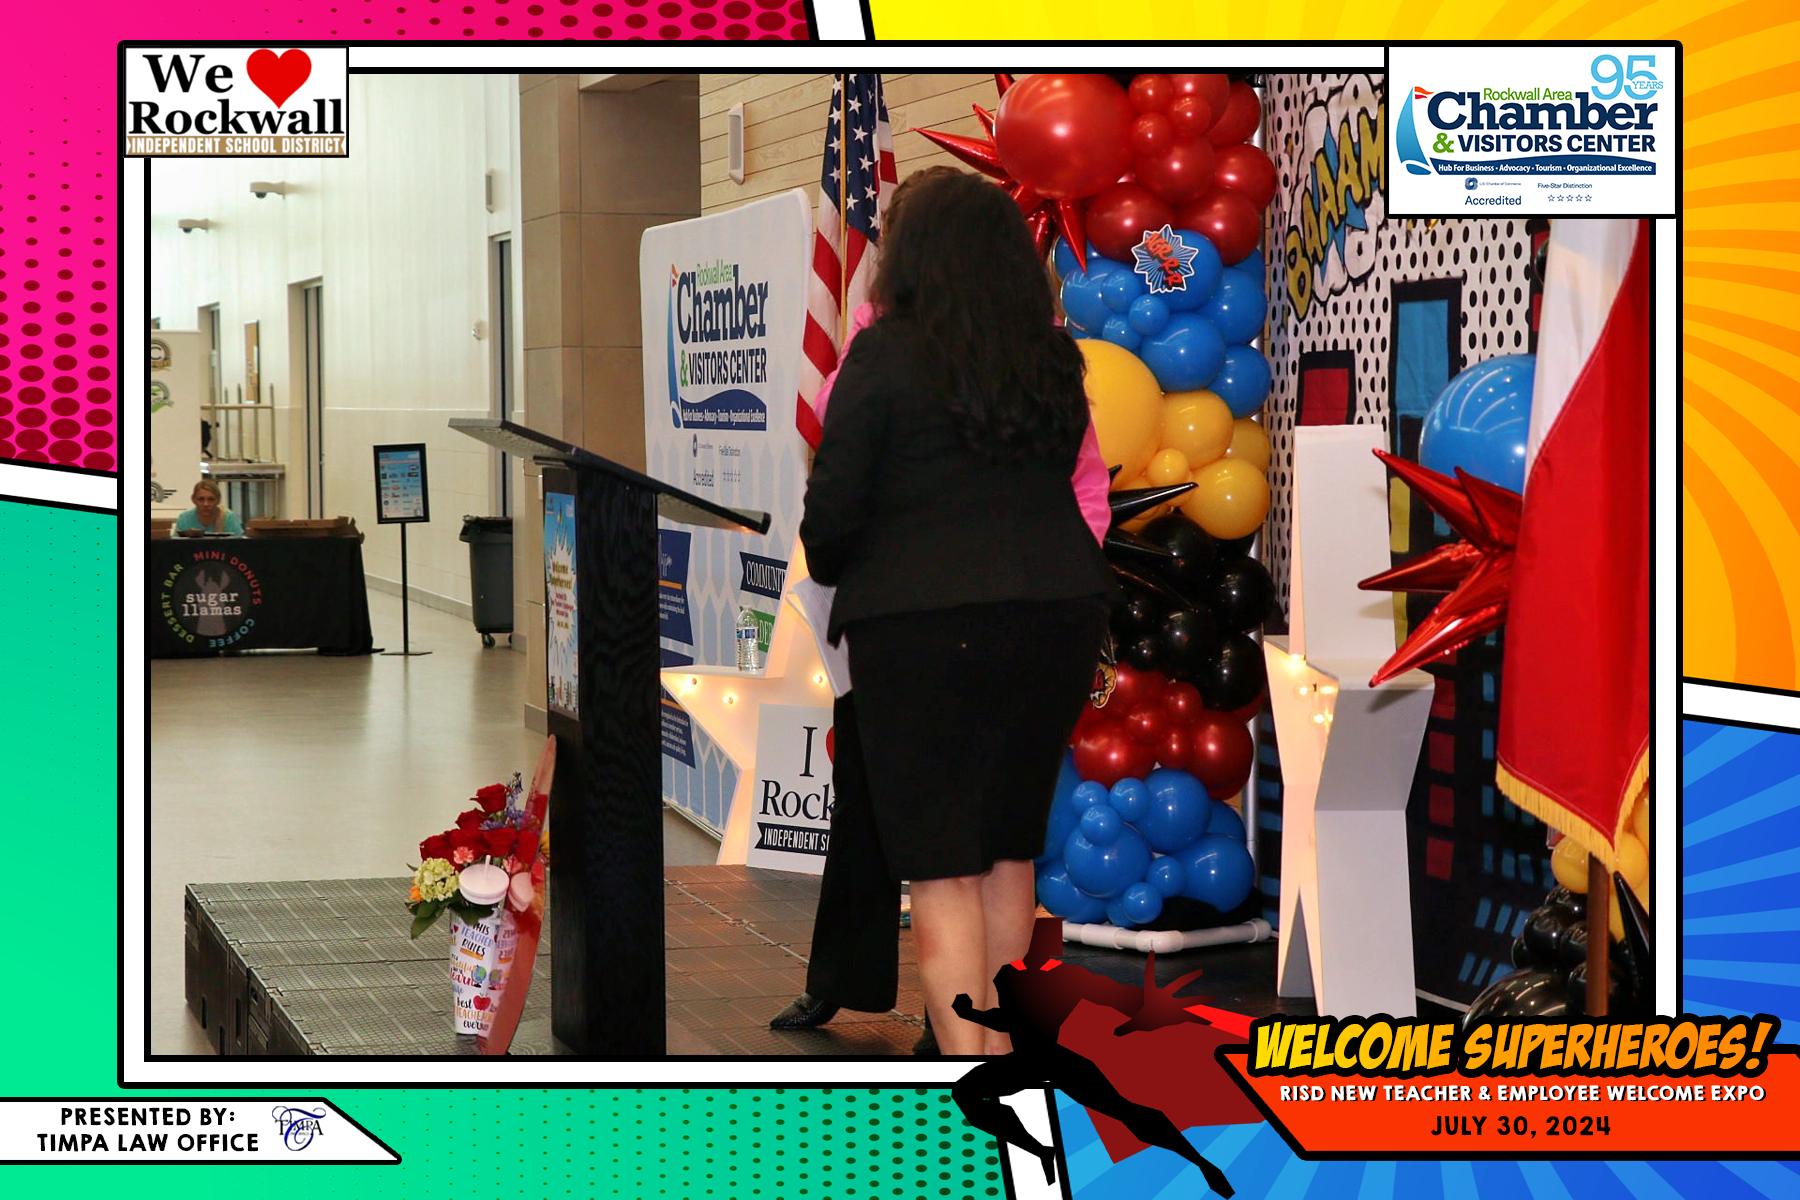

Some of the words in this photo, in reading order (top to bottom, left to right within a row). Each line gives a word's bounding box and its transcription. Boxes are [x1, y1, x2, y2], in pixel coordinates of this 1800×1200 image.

[677, 264, 769, 344] Chamber
[680, 350, 689, 388] &
[688, 350, 729, 386] VISITORS
[730, 347, 767, 384] CENTER
[164, 563, 184, 588] BAR
[193, 551, 225, 561] MINI
[229, 556, 263, 606] DONUTS
[182, 604, 243, 617] llamas
[185, 592, 239, 607] sugar
[161, 592, 195, 644] DESSERT
[208, 618, 255, 648] COFFEE
[799, 725, 818, 778] I
[763, 827, 819, 851] INDEPENDENT
